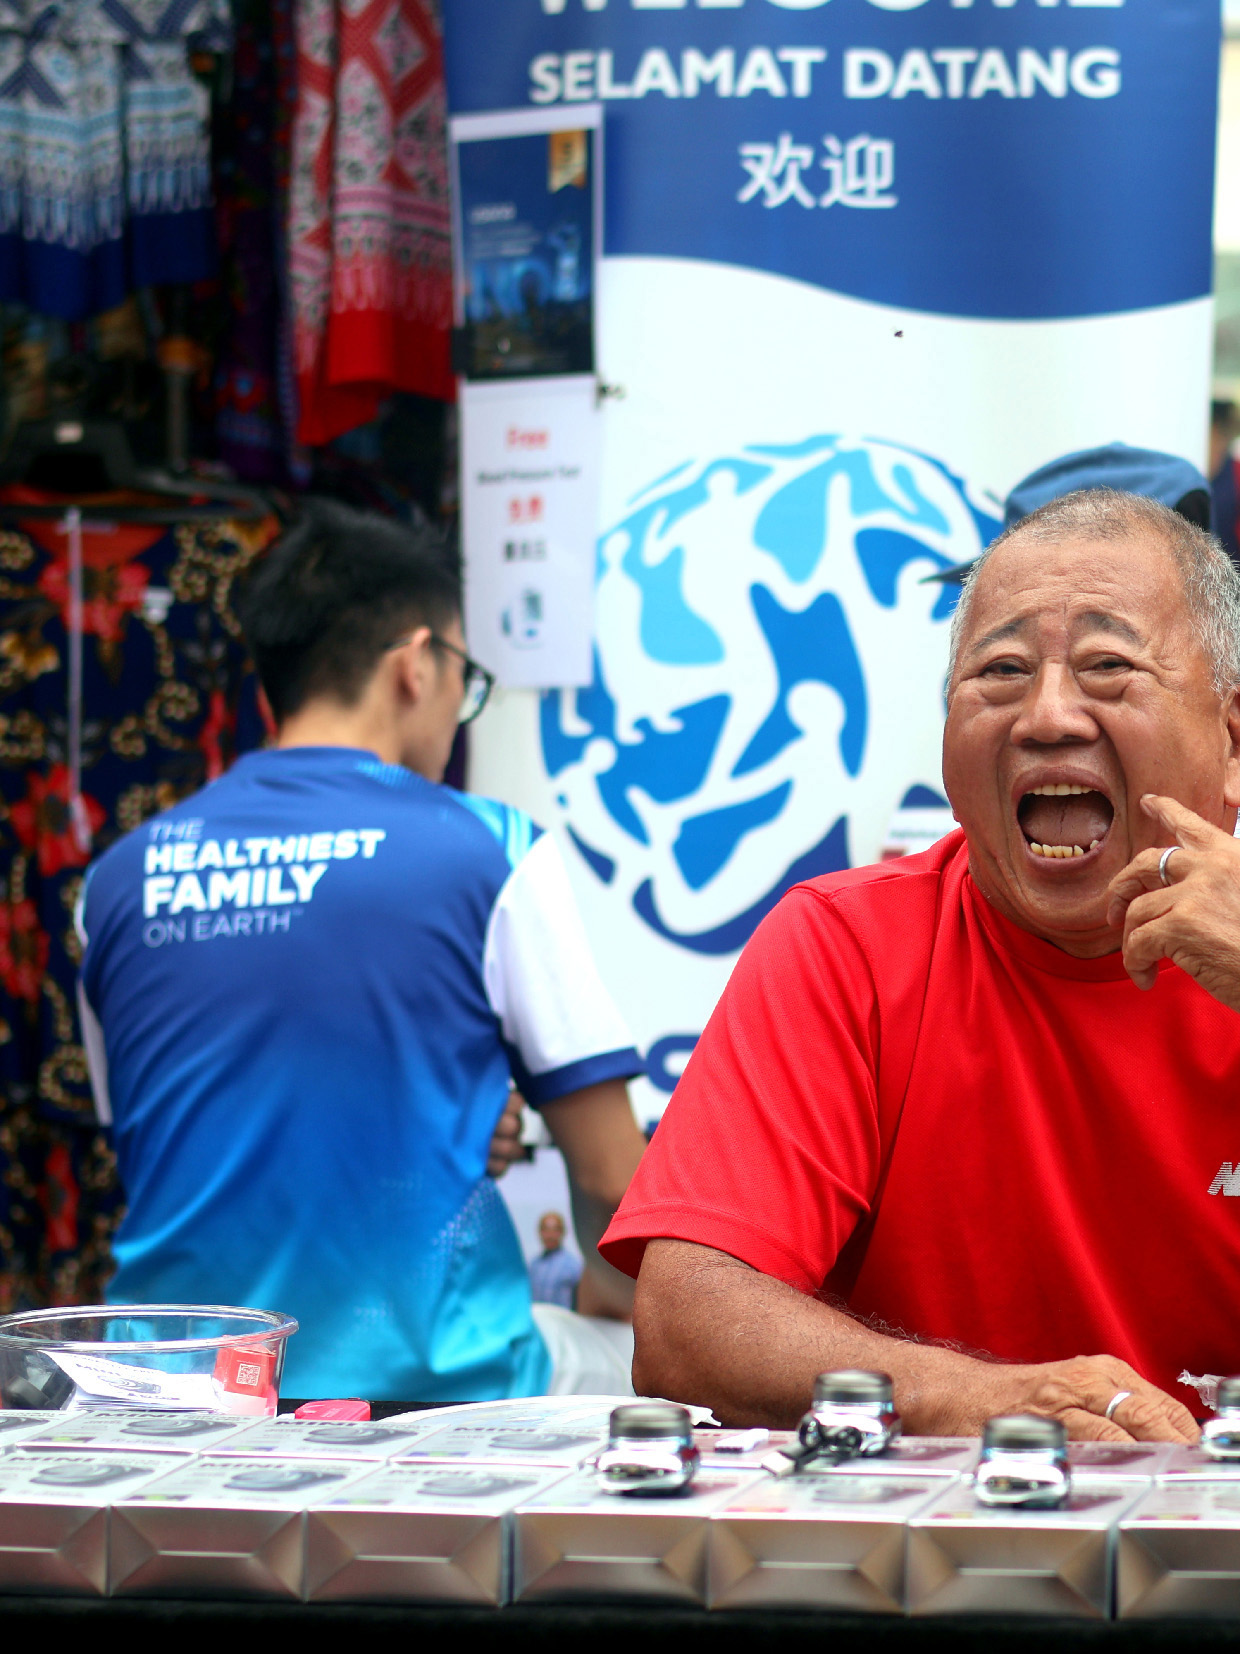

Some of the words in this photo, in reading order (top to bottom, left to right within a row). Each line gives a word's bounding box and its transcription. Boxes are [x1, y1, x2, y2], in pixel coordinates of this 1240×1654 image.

[529, 46, 827, 102] SELAMAT
[842, 46, 1120, 99] DATANG
[738, 132, 898, 208] 欢迎
[144, 828, 386, 876] HEALTHIEST
[149, 818, 204, 843] THE
[143, 863, 328, 919] FAMILY
[143, 918, 187, 949] ON
